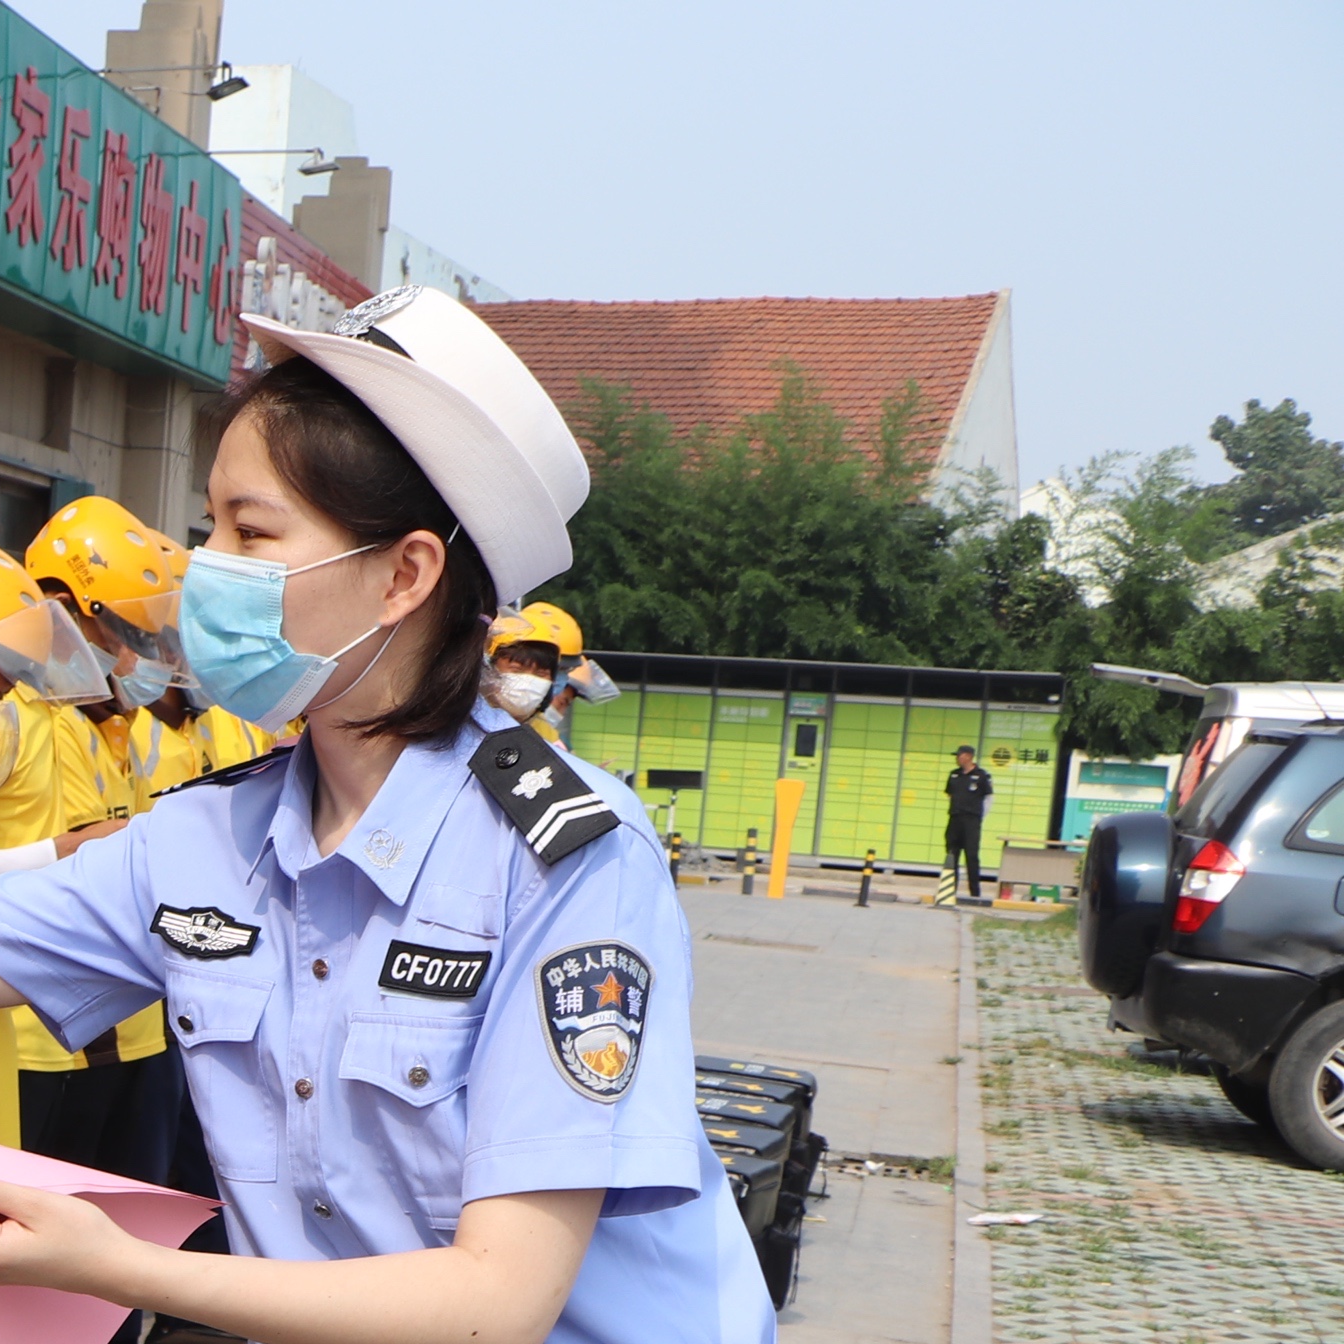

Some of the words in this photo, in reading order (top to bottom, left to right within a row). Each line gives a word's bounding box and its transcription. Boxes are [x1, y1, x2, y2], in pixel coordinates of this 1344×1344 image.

[391, 952, 483, 988] CF0777
[546, 949, 648, 990] 中华人民共和国
[555, 986, 584, 1015] 辅
[627, 986, 643, 1017] 警
